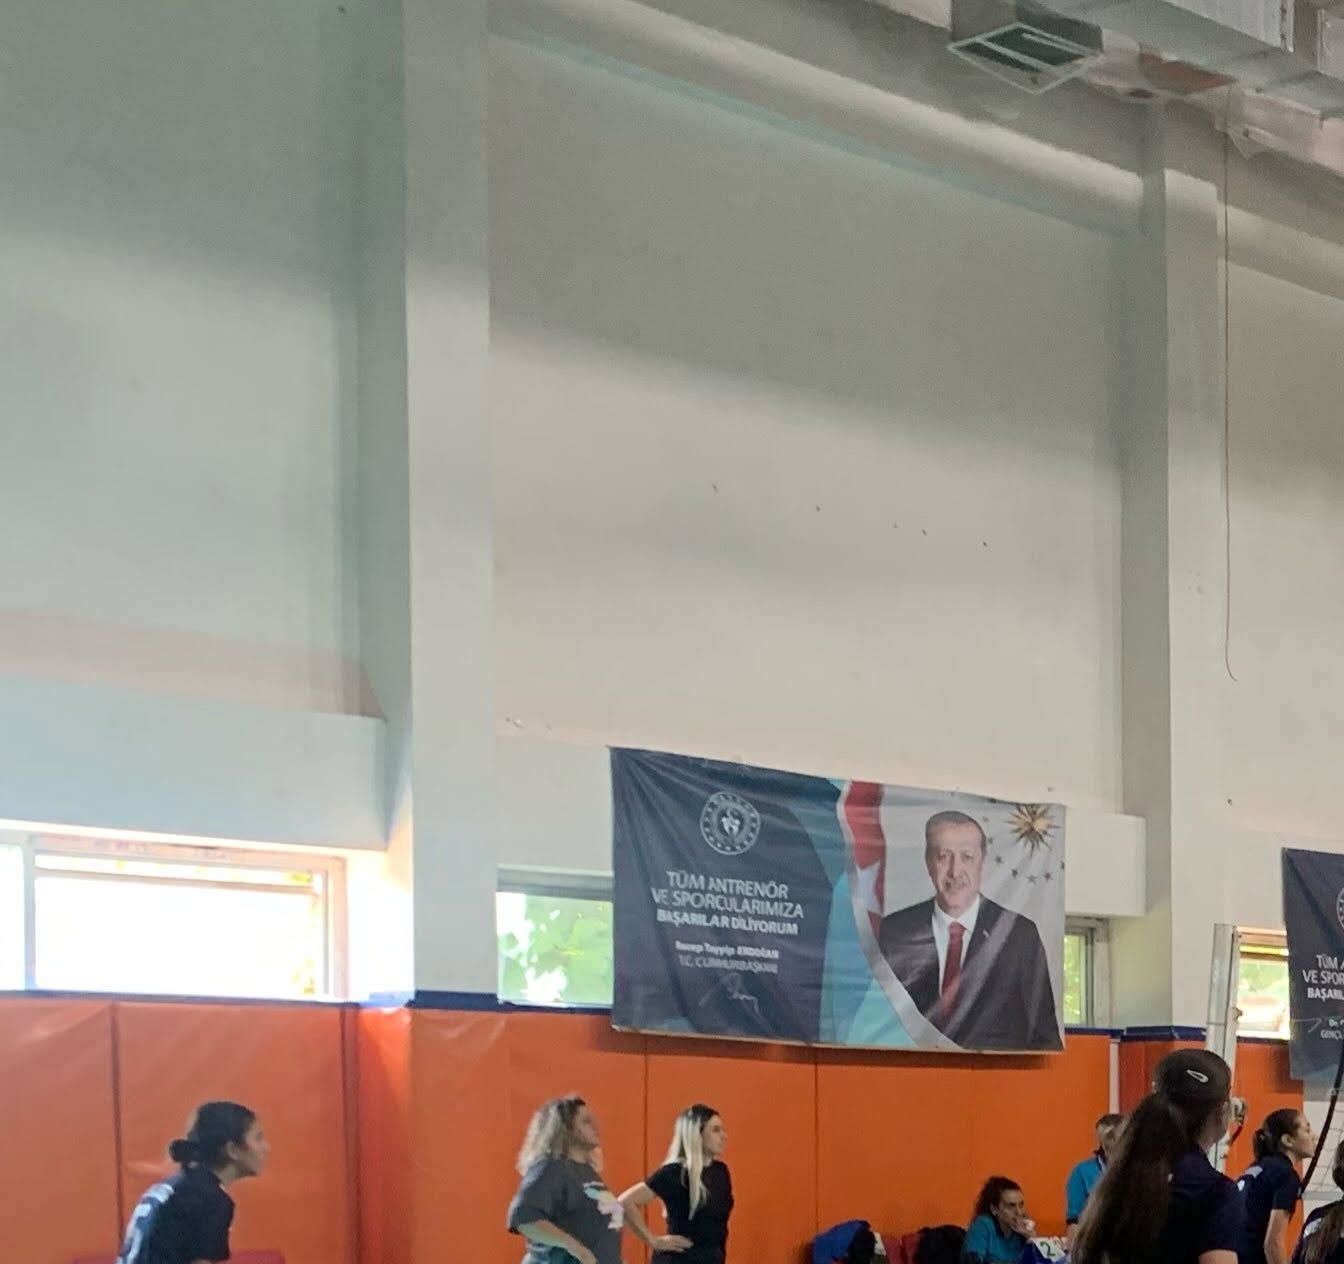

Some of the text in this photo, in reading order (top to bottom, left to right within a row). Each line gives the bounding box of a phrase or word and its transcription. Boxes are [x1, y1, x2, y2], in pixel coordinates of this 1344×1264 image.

[666, 870, 789, 899] TÜM ANTRENÖR
[651, 887, 804, 919] VE SPORCULARIMIZA
[656, 909, 798, 936] BAŞARILAR DİLİYORUM
[1316, 953, 1338, 970] TÜM
[1302, 969, 1318, 983] VE
